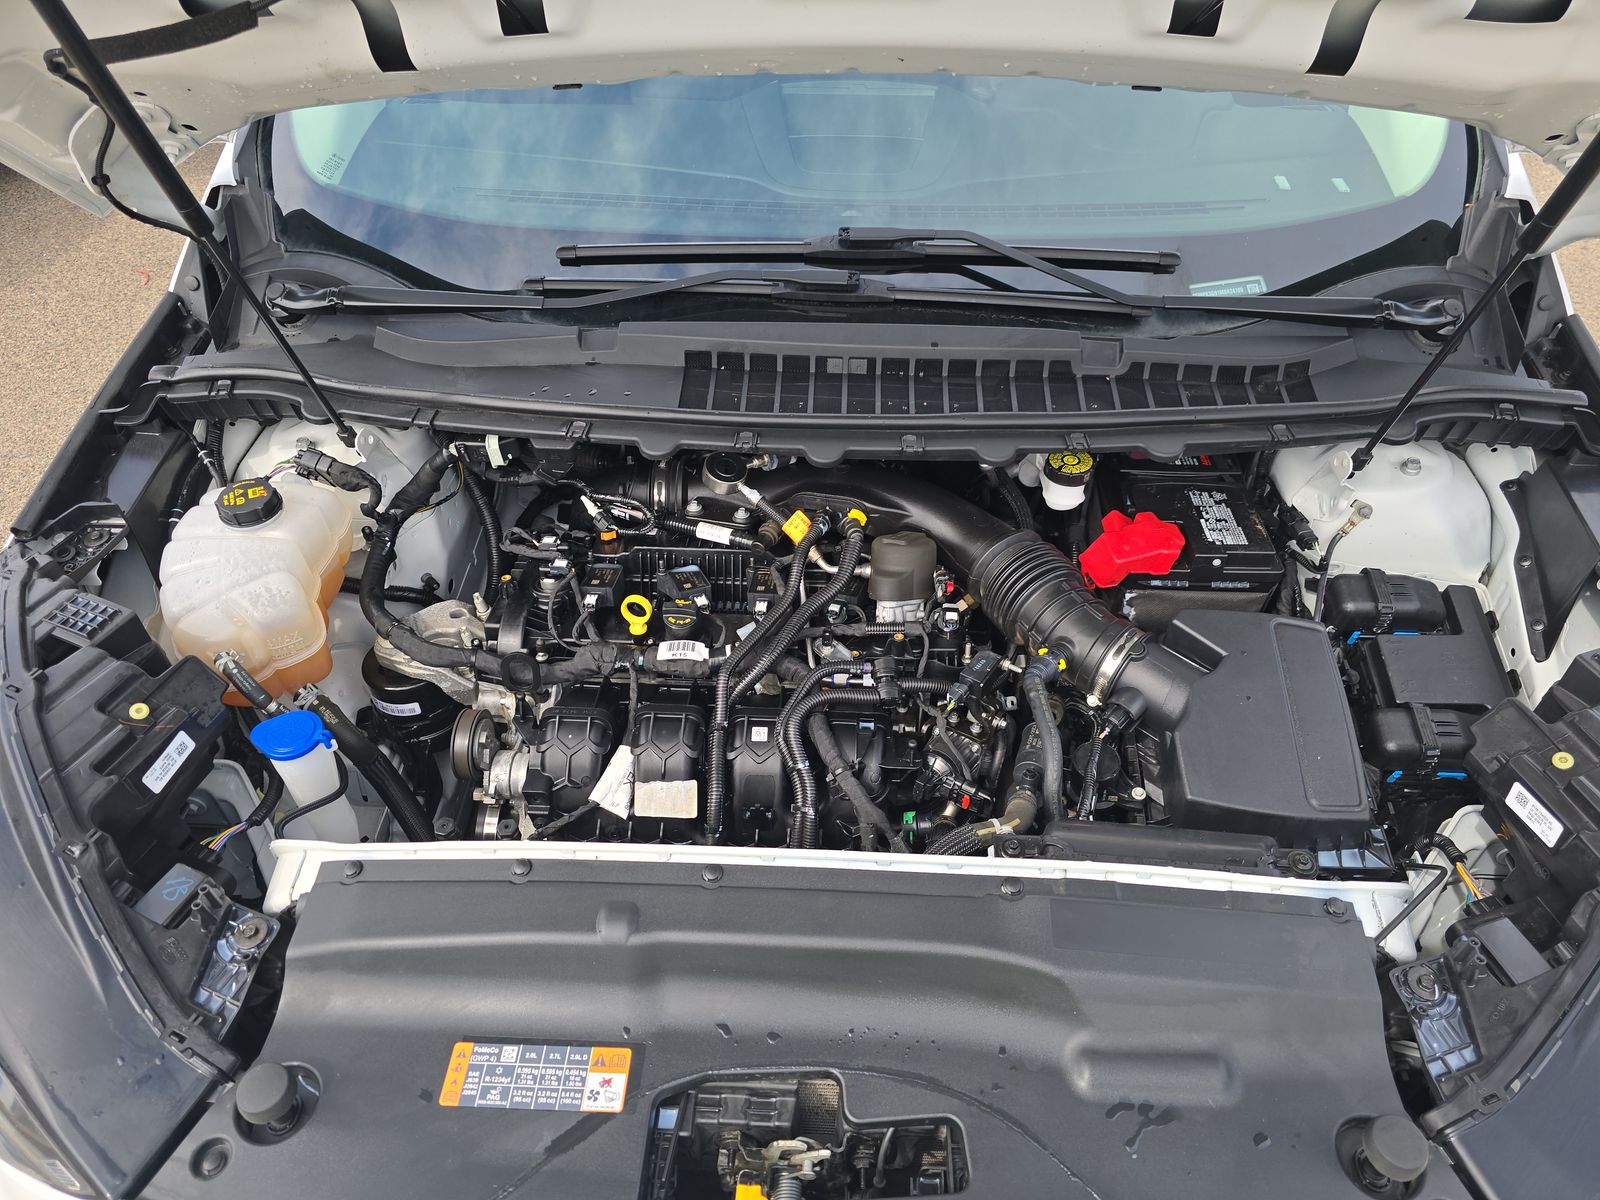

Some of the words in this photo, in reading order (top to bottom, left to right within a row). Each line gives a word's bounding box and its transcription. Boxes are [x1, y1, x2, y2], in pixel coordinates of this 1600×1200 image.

[473, 1046, 499, 1054] FoMoCo
[532, 1068, 539, 1076] kg
[556, 1069, 563, 1077] kg
[484, 1076, 511, 1084] R-1234yf
